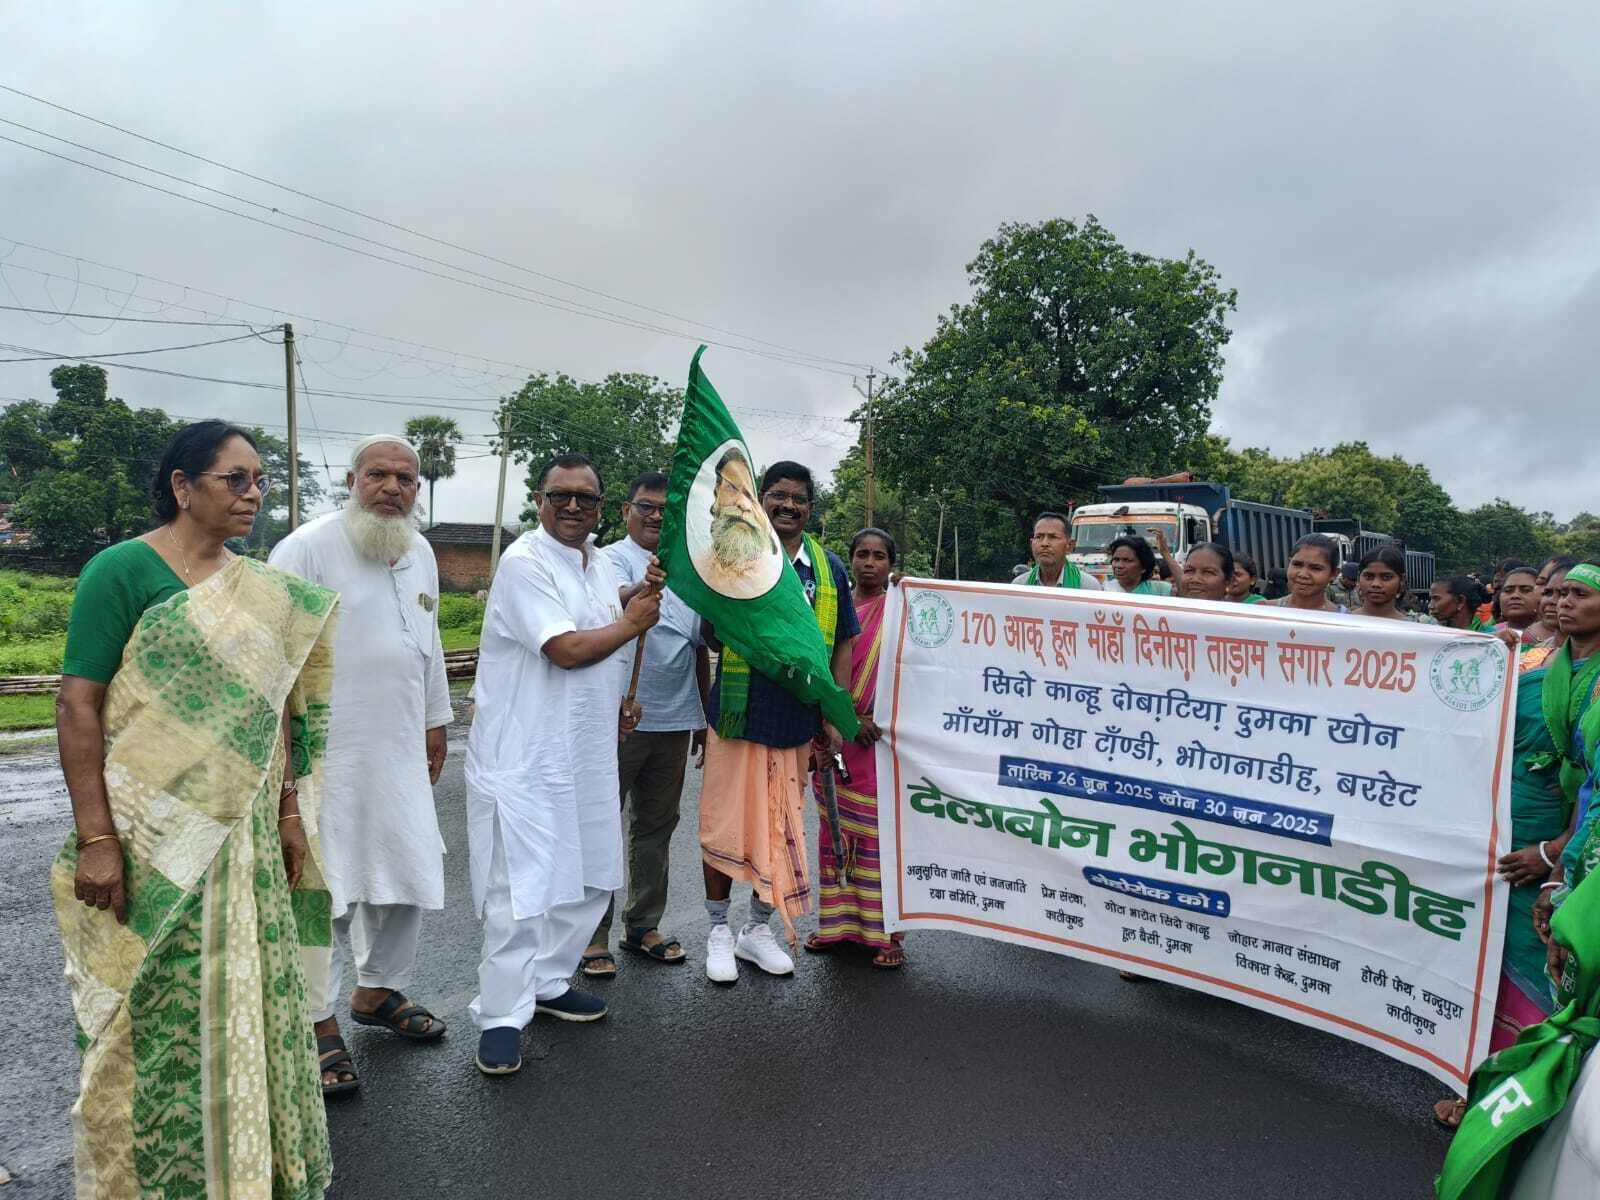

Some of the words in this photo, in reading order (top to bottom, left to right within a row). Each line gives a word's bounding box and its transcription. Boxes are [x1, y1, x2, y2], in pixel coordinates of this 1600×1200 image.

[960, 610, 996, 647] 170
[1050, 620, 1079, 671] हूल
[1086, 609, 1126, 664] माँहाँ
[1205, 635, 1269, 687] ताड़ाम
[1276, 629, 1335, 687] संगार
[1344, 648, 1418, 693] 2025
[982, 667, 1036, 697] सिदो
[1044, 680, 1102, 715] कान्हू
[1235, 704, 1318, 738] दुमका
[1327, 713, 1405, 750] खोन
[942, 706, 1023, 739] माँयाँम
[1030, 718, 1087, 750] गोहा
[1176, 740, 1322, 796] भोगनाडीह,
[1336, 770, 1422, 807] बरहेट
[1057, 771, 1076, 787] 26
[1082, 775, 1108, 795] जून
[1115, 781, 1154, 800] 2025
[1158, 790, 1199, 811] खोन
[1204, 800, 1226, 817] 30
[1231, 806, 1266, 827] जून
[1271, 812, 1319, 835] 2025
[906, 776, 1116, 858] देलाबोन
[1129, 820, 1476, 941] भोगनाडीह
[906, 863, 948, 881] अनुसूचित
[950, 868, 971, 883] जाति
[974, 871, 987, 886] एवं
[989, 878, 1027, 893] जनजाति
[929, 888, 946, 900] रक्षा
[948, 889, 979, 907] समिति,
[981, 897, 1007, 912] दुमका
[1040, 883, 1057, 899] प्रेम
[1045, 908, 1085, 930] काठीकुण्ड
[1104, 900, 1126, 916] गोटा
[1160, 913, 1183, 929] सिदो
[1185, 921, 1210, 940] कान्हू
[1121, 926, 1137, 942] हूल
[1139, 926, 1163, 948] बैसी,
[1165, 937, 1193, 954] दुमका
[1227, 929, 1259, 948] जोहार
[1261, 939, 1294, 957] मानव
[1296, 944, 1341, 972] संसाधन
[1235, 952, 1272, 976] विकास
[1301, 975, 1332, 995] दुमका
[1360, 965, 1389, 988] होली
[1392, 975, 1416, 1001] फेथ,
[1421, 988, 1464, 1020] चन्दुपुरा
[1386, 1003, 1437, 1035] काठीकुण्ड
